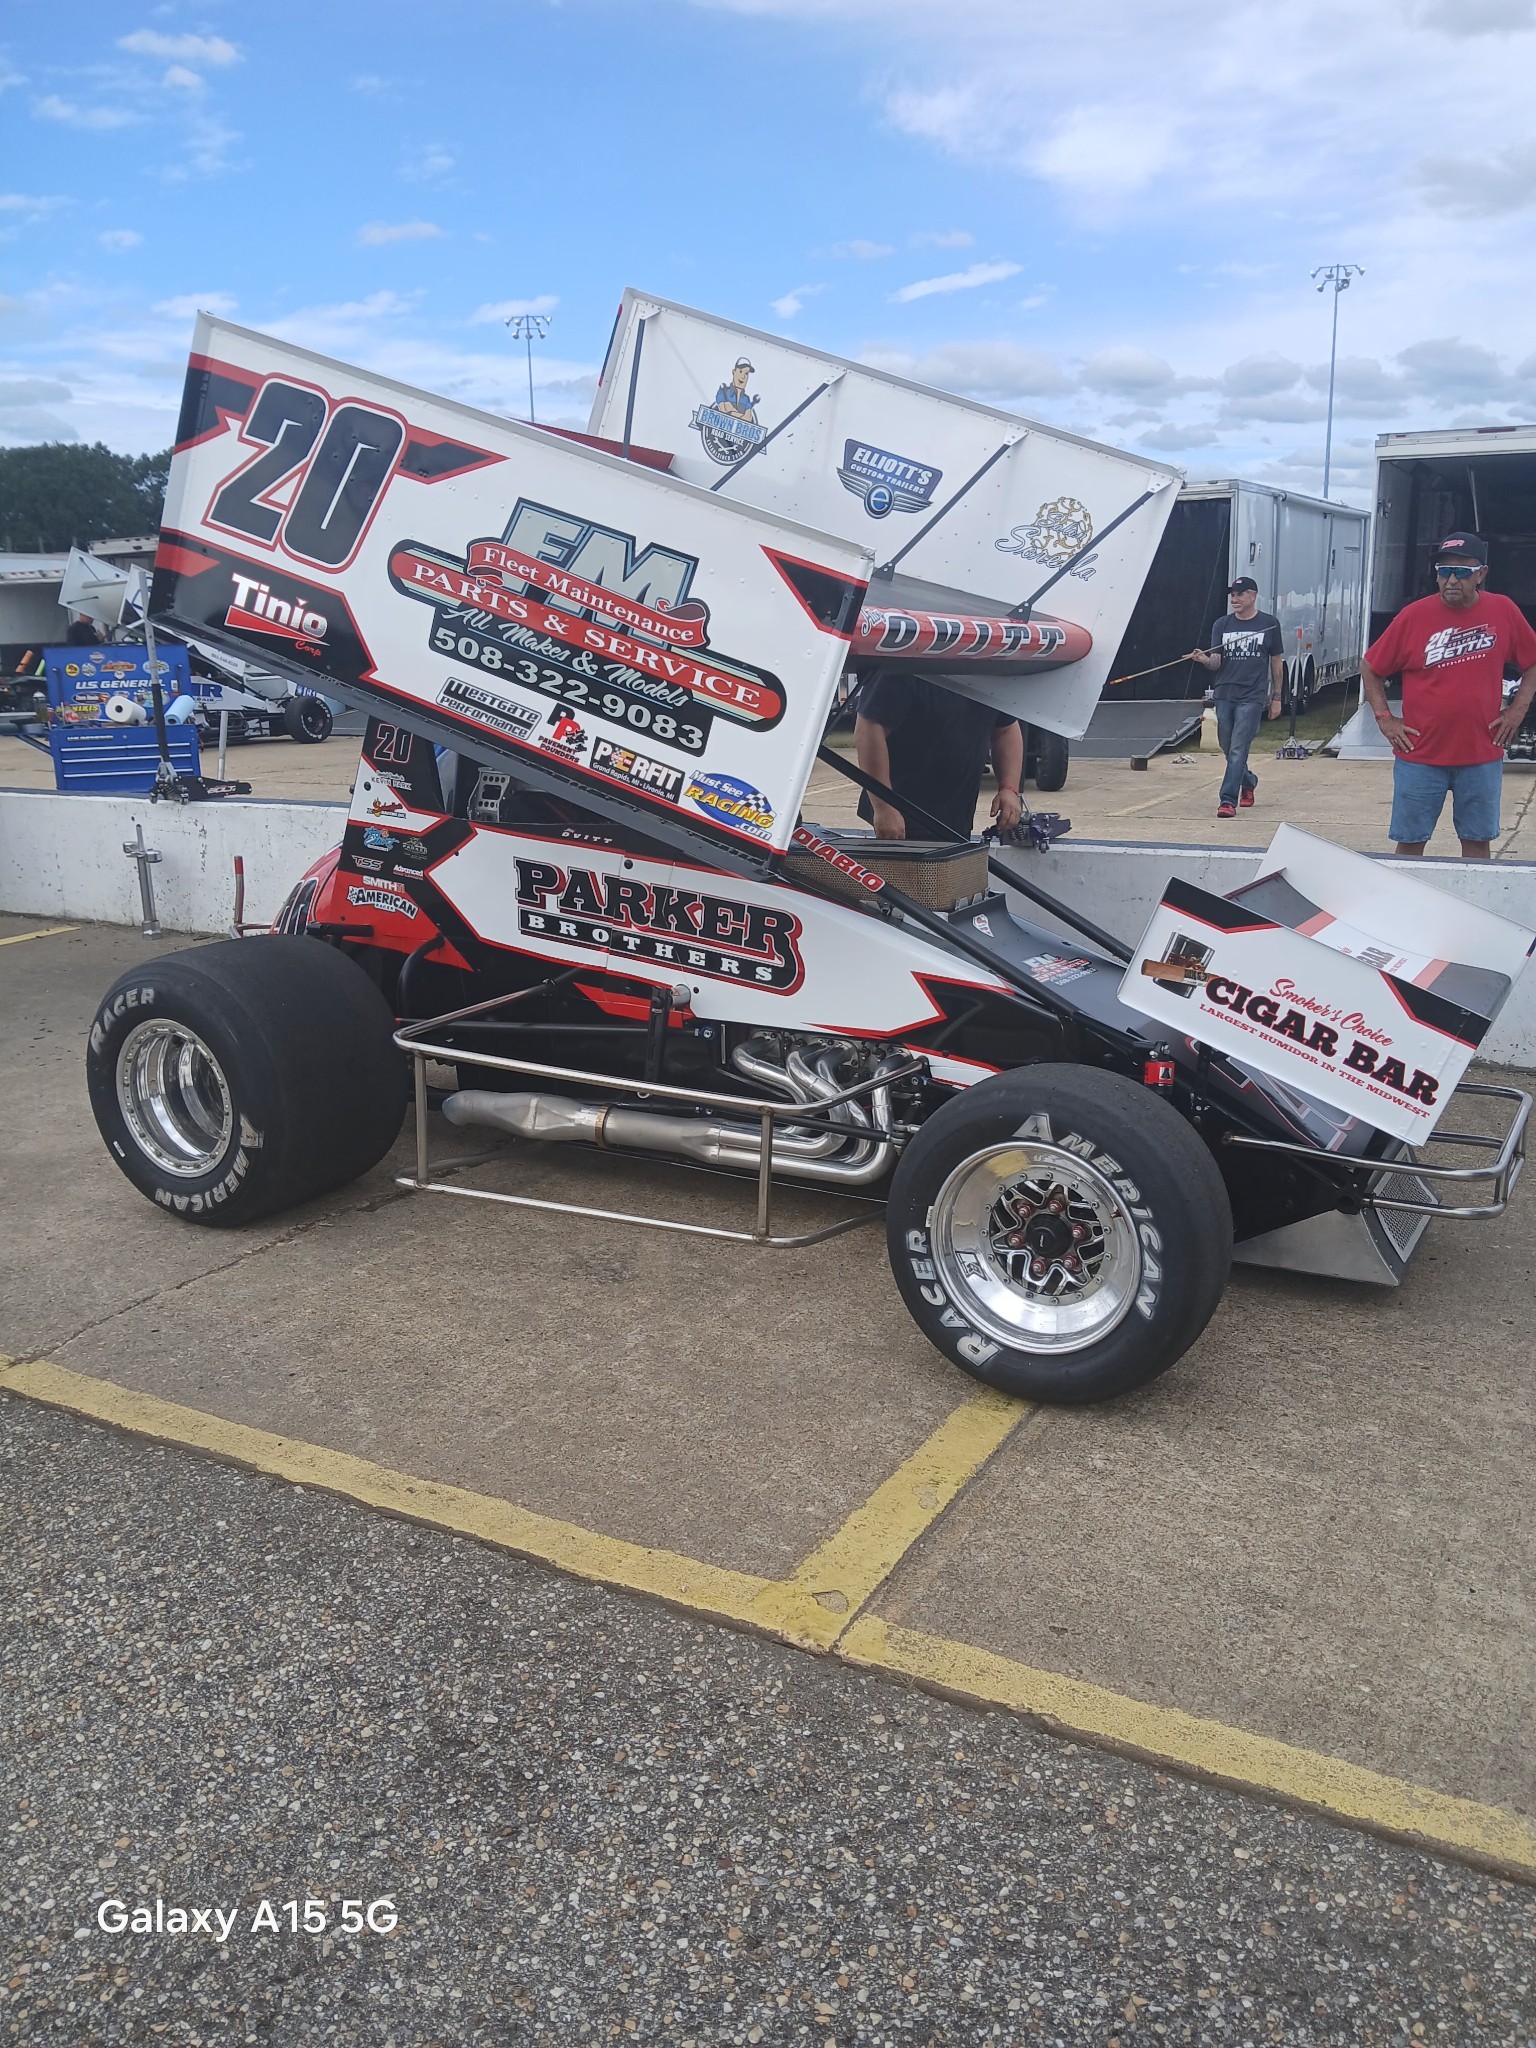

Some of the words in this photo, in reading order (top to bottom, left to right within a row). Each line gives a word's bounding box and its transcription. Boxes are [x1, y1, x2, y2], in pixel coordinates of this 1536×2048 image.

[701, 409, 734, 432] BROWN
[736, 423, 760, 441] BROS
[711, 429, 724, 438] ROAD
[725, 433, 744, 446] SERVICE
[203, 373, 406, 573] 20
[850, 464, 884, 480] CUSTOM
[887, 476, 925, 494] TRAILERS
[852, 447, 932, 485] ELLIOTT'S
[232, 573, 327, 637] Tinio
[483, 546, 540, 581] Fleet
[544, 573, 694, 641] Maintenance
[295, 641, 321, 656] Corp
[412, 563, 527, 619] PARTS
[543, 614, 569, 635] &
[585, 628, 760, 708] SERVICE
[441, 607, 493, 630] All
[498, 622, 571, 662] Makes
[572, 651, 598, 676] &
[603, 664, 690, 707] Models
[100, 678, 166, 688] GENERL
[434, 627, 703, 748] 508-322-9083
[374, 723, 413, 764] 20
[538, 735, 577, 755] PAVEMENT
[540, 744, 580, 763] POUNDERS
[592, 762, 610, 774] Grand
[610, 770, 630, 783] Rapids,
[631, 778, 640, 786] MI
[666, 792, 675, 801] MI
[684, 785, 774, 829] RACING
[690, 771, 722, 789] Must
[722, 782, 744, 798] See
[734, 824, 772, 841] .com
[792, 827, 886, 892] DIABLO
[355, 887, 417, 918] AMERICAN
[514, 856, 802, 965] PARKER
[528, 914, 772, 981] BROTHERS
[90, 987, 155, 1053] RACER
[1206, 977, 1339, 1058] CIGAR
[1343, 1040, 1439, 1106] BAR
[1269, 979, 1341, 1022] Smoker's
[1340, 1012, 1394, 1047] Choice
[1199, 1004, 1258, 1035] LARGEST
[1258, 1032, 1318, 1064] HUMIDOR
[1320, 1061, 1336, 1074] IN
[1338, 1070, 1364, 1087] THE
[1366, 1083, 1430, 1119] MIDWEST
[155, 1113, 264, 1213] AMERICAN
[1012, 1113, 1164, 1320] AMERICAN
[905, 1230, 1003, 1367] RACER
